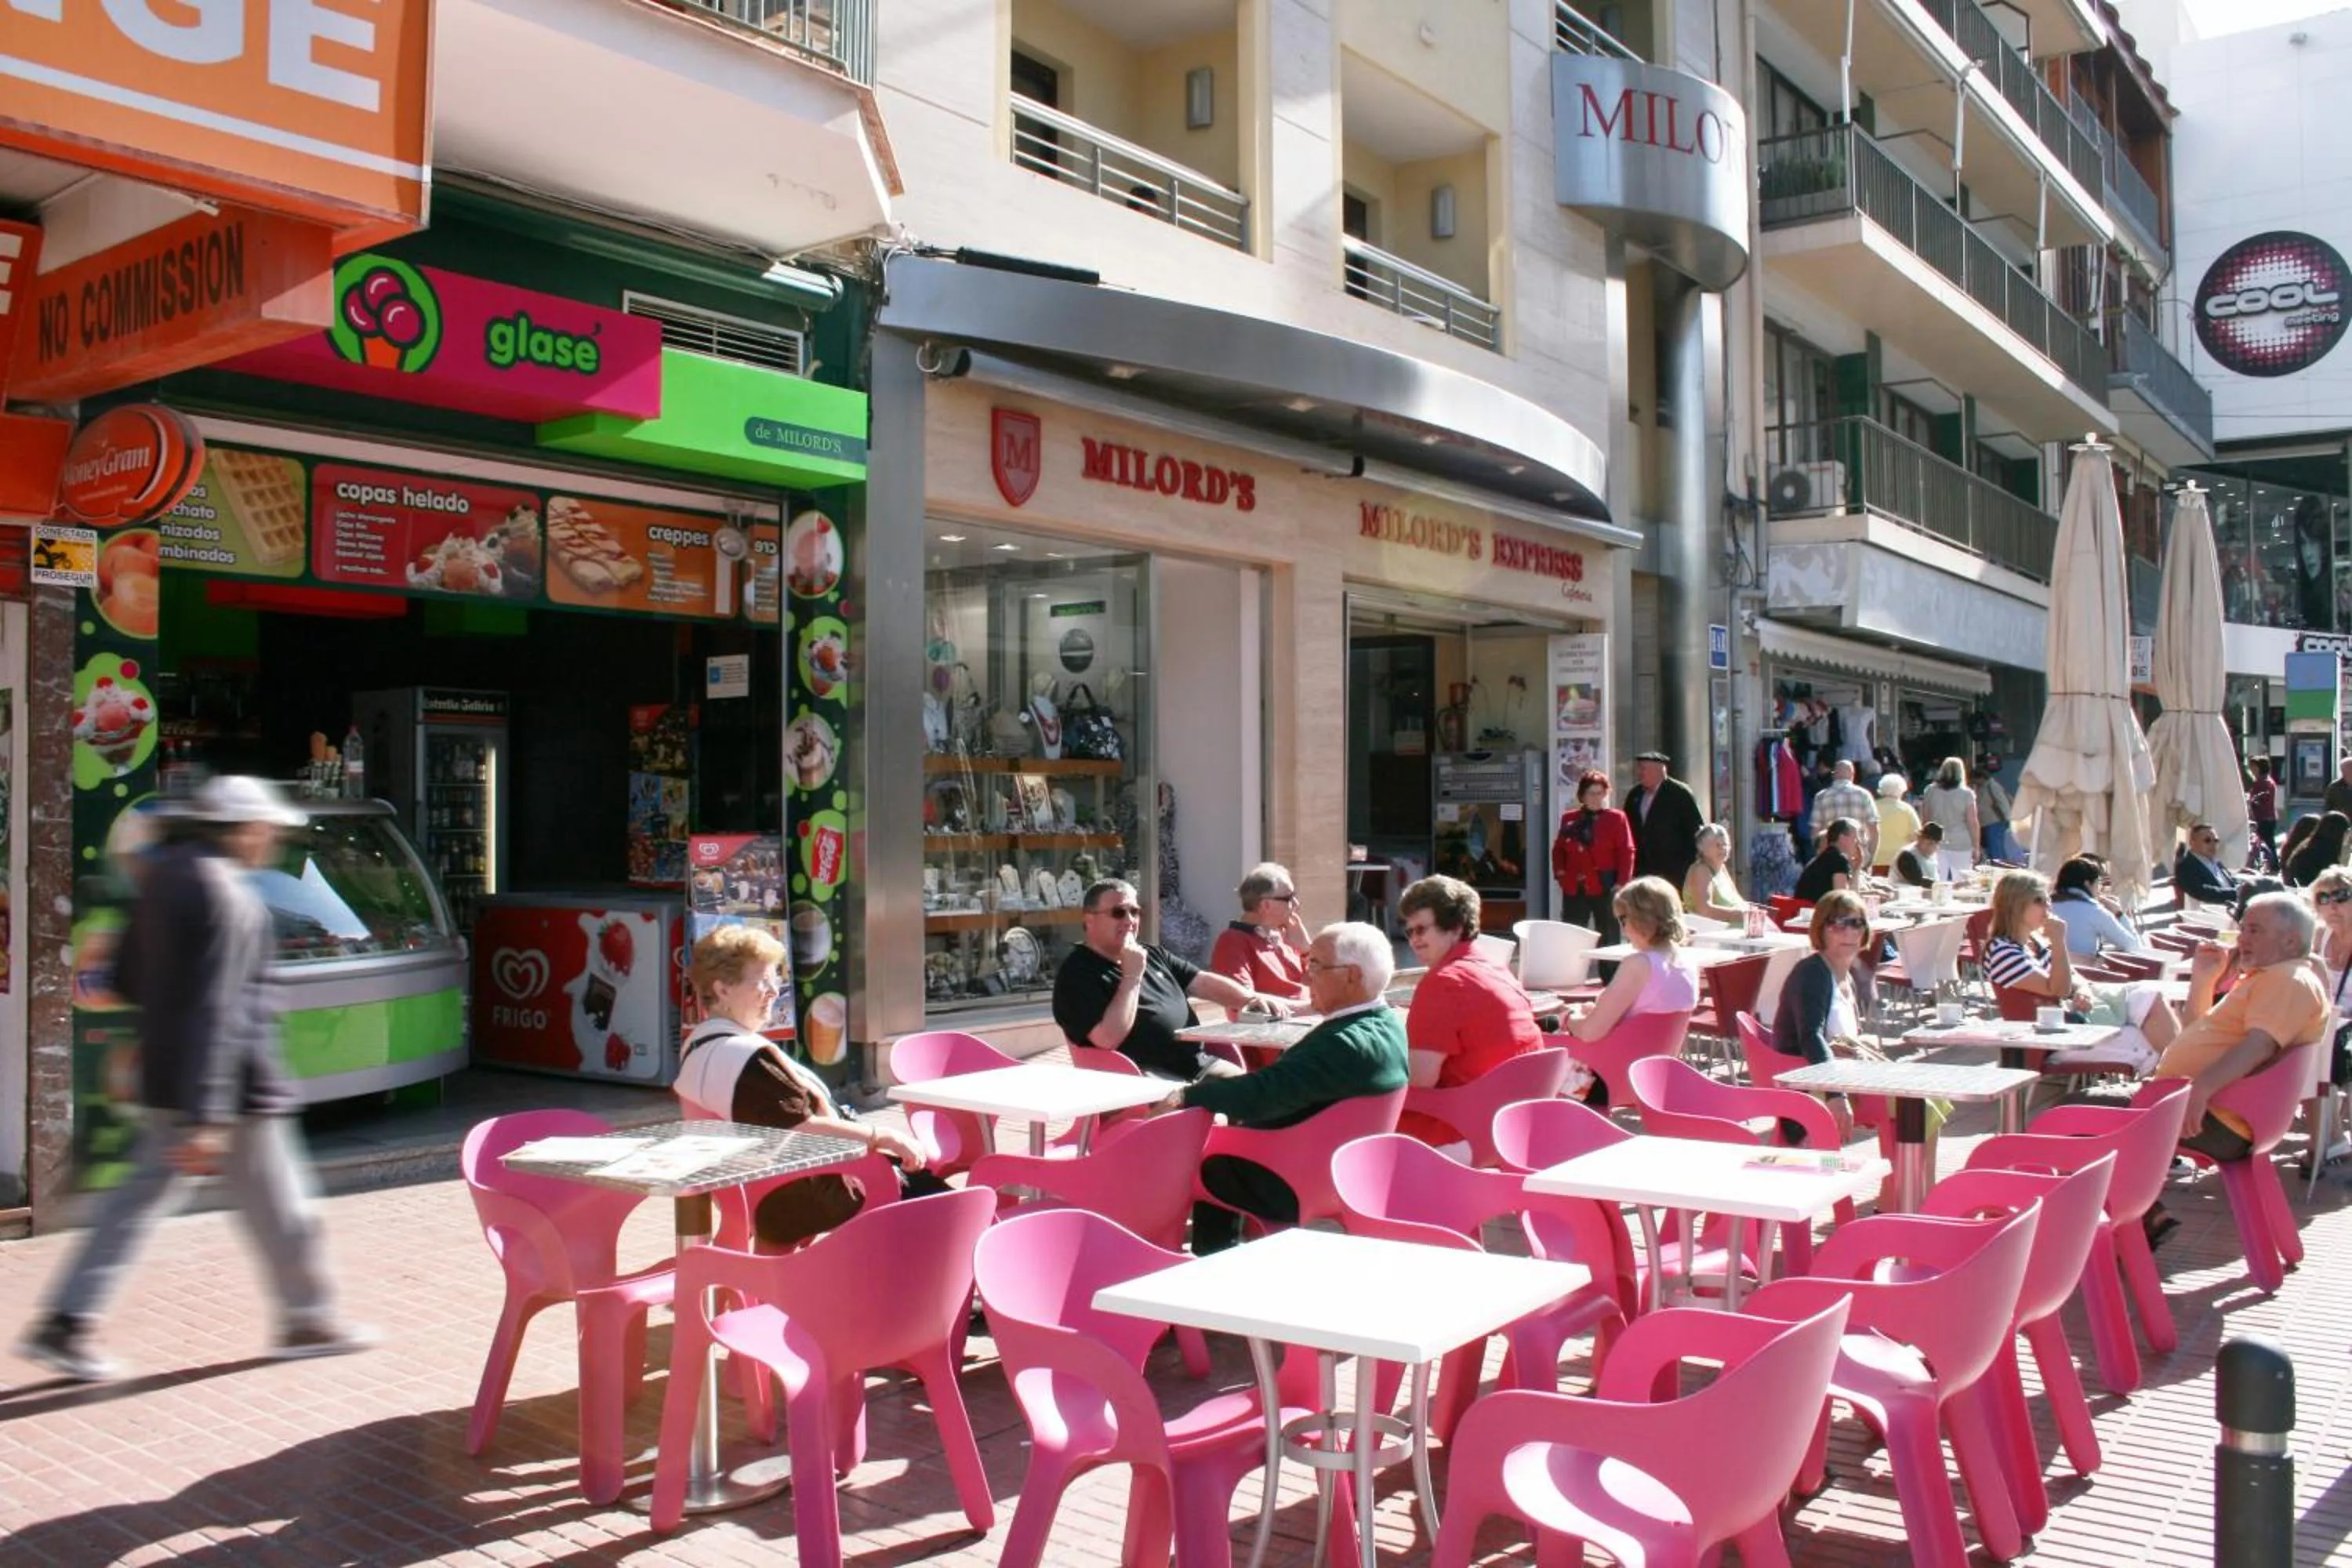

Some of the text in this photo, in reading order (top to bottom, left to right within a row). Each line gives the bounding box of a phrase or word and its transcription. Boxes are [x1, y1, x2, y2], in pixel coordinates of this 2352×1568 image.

[38, 290, 68, 362] NO
[79, 220, 245, 350] COMMISSION
[2205, 281, 2339, 318] COOL
[754, 423, 843, 454] de MILORD'S
[1002, 430, 1032, 470] M
[1080, 435, 1256, 512] MILORD'S
[336, 482, 470, 514] copas helado
[160, 523, 220, 540] nizados
[648, 524, 709, 547] creppes
[1359, 499, 1584, 583] MILORD'S EXPRESS
[158, 544, 235, 564] mbinados
[492, 1005, 546, 1030] FRIGO
